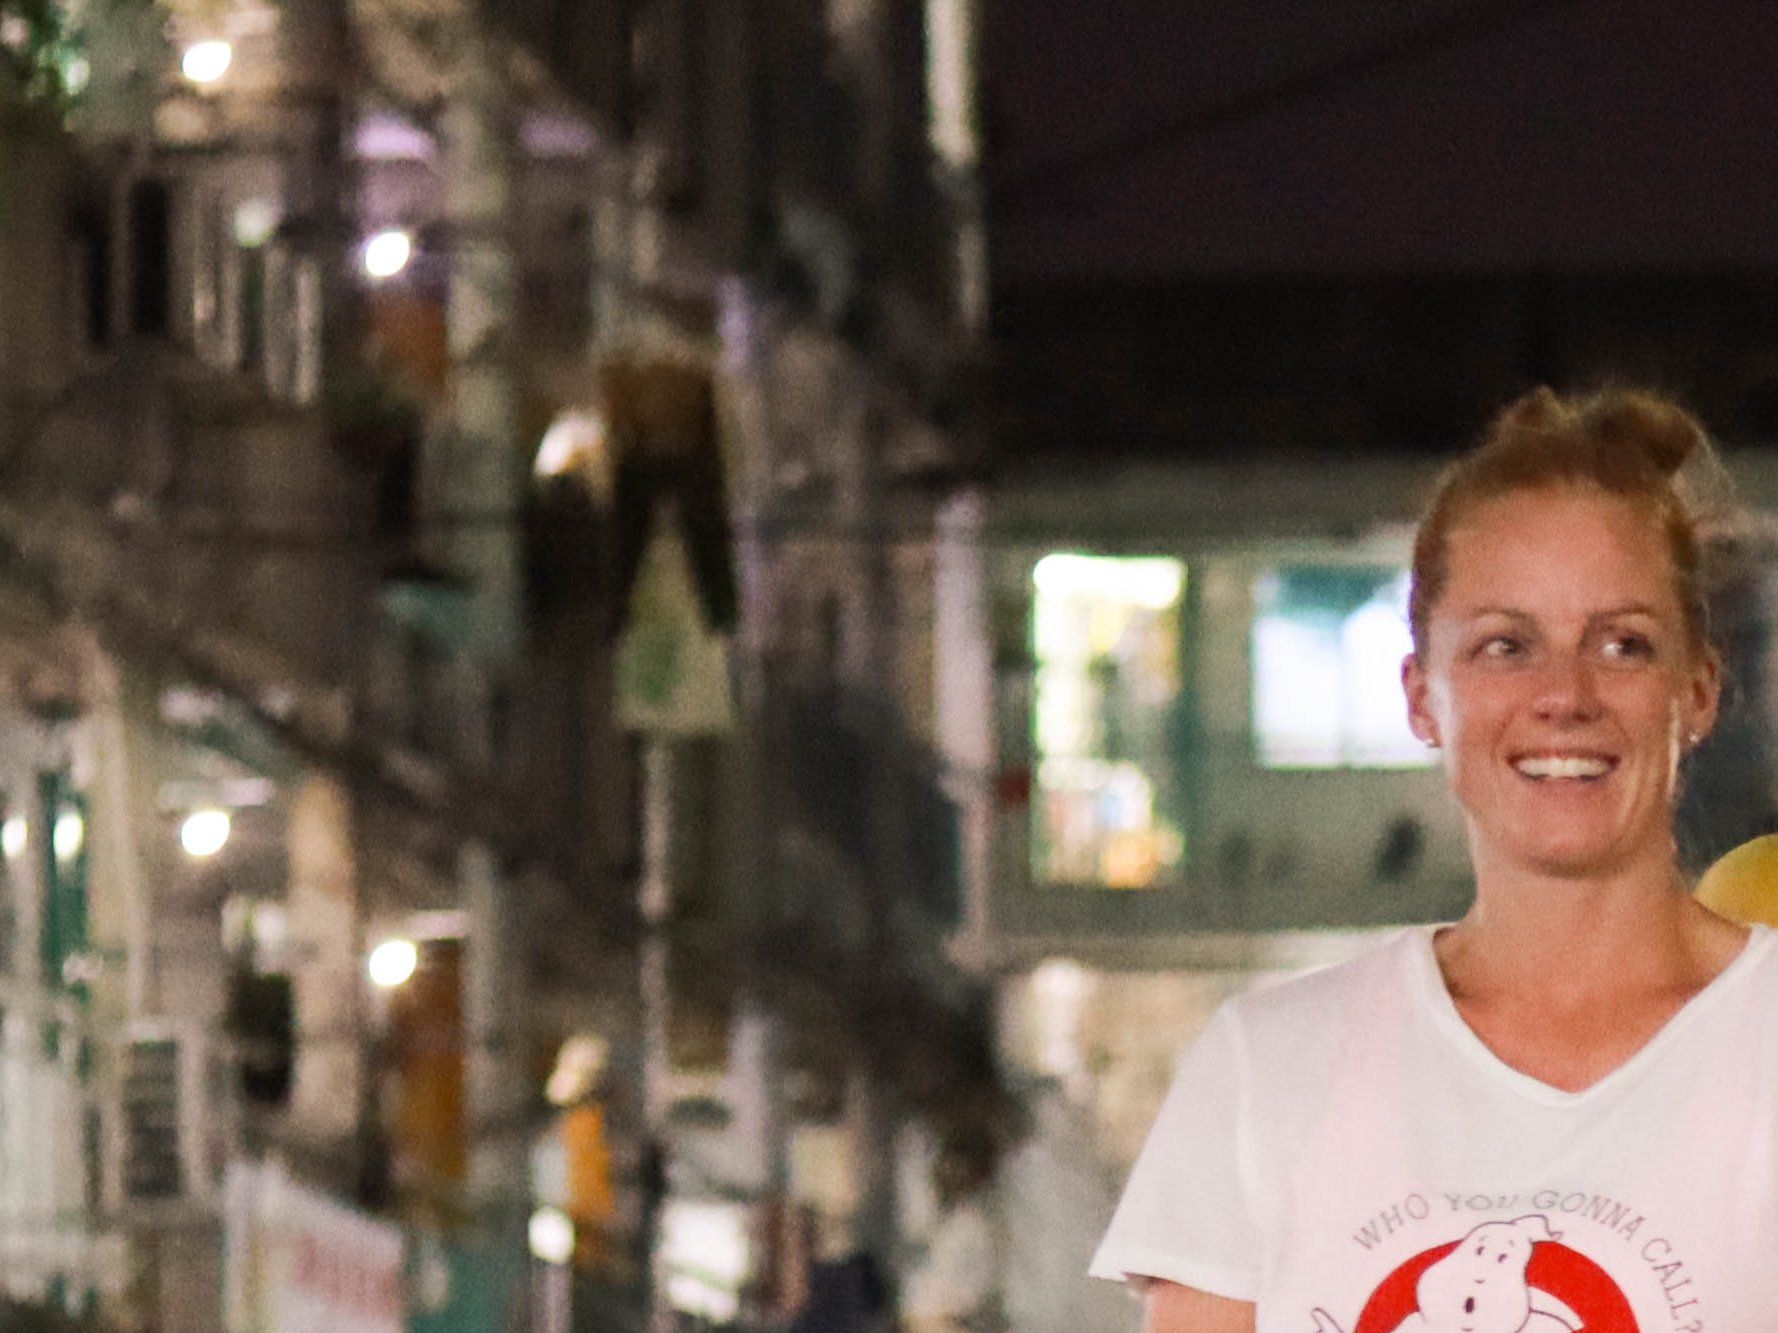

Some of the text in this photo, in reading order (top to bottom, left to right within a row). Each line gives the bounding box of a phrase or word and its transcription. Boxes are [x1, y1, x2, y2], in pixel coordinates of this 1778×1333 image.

[1353, 1190, 1704, 1333] WHO YOU GONNA CALL?
